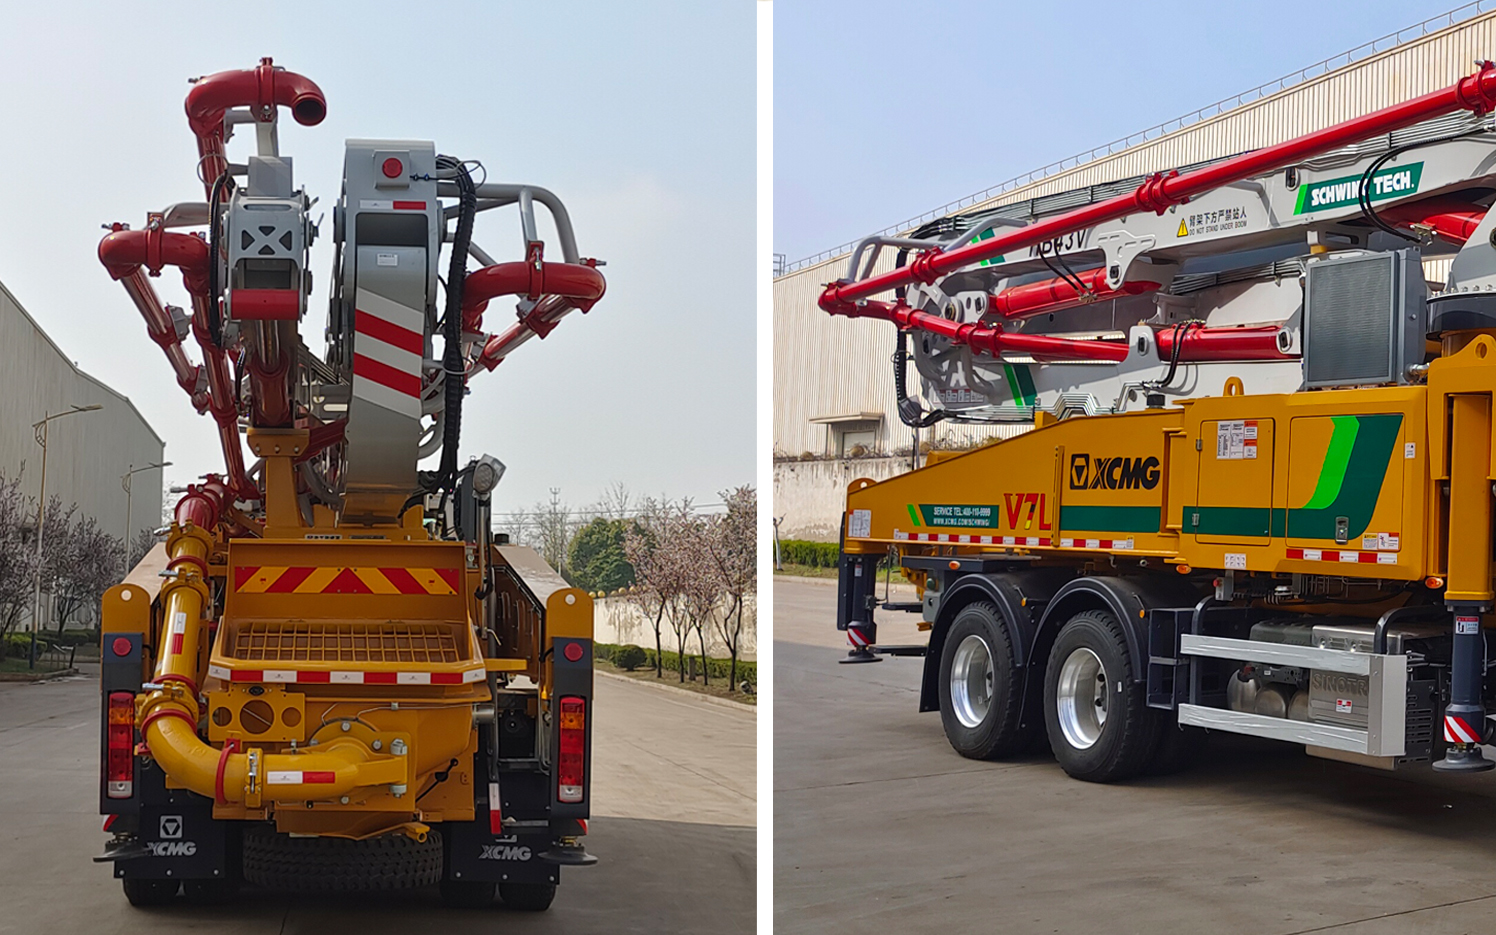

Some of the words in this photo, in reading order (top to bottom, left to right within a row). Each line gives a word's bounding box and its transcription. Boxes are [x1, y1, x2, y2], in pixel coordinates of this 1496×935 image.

[1373, 170, 1415, 195] TECH.
[1189, 228, 1196, 236] DO
[1197, 226, 1205, 235] NOT
[1206, 224, 1219, 233] STAND
[1220, 222, 1234, 231] UNDER
[1088, 456, 1160, 490] XCMG
[933, 506, 953, 516] SERVICE
[1003, 493, 1051, 530] V7L
[1312, 673, 1369, 698] SINOTR
[478, 845, 532, 861] XCMG
